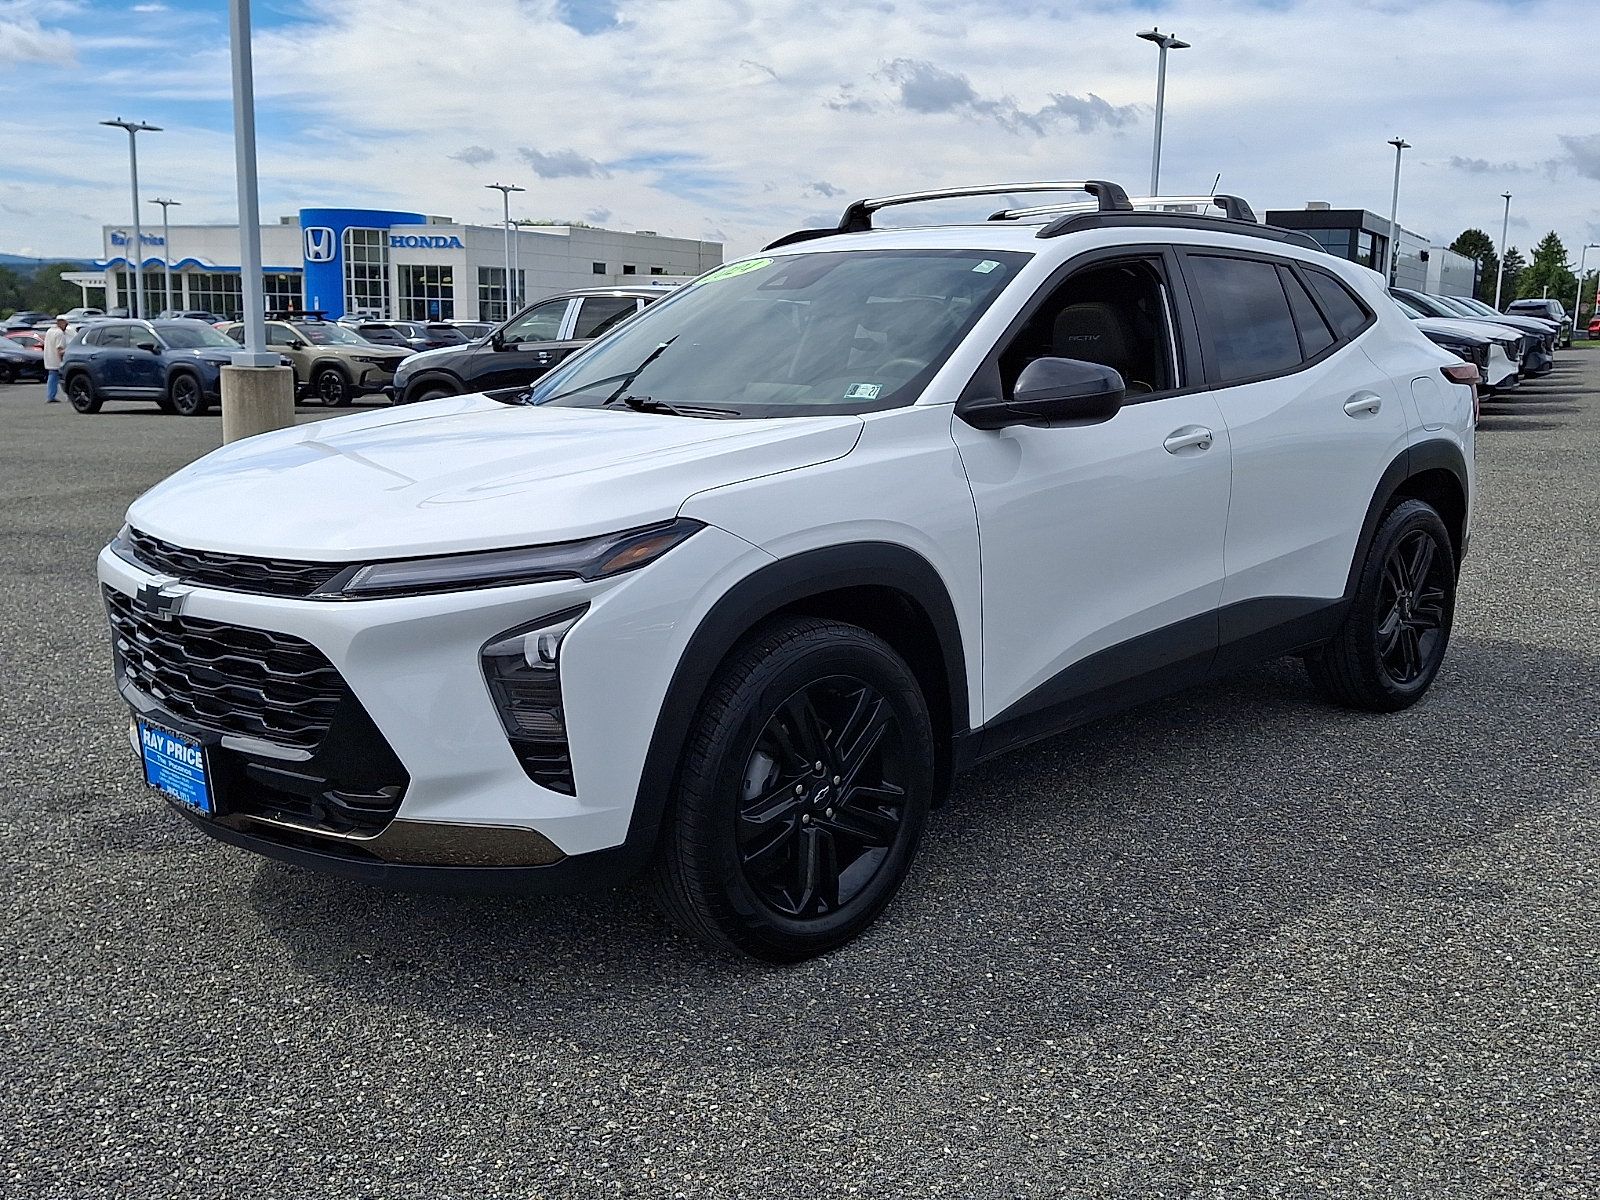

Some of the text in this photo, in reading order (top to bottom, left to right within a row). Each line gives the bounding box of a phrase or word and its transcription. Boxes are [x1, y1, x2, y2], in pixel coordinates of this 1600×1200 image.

[389, 235, 464, 250] HONDA
[143, 729, 164, 752] RAY
[166, 740, 203, 769] PRICE
